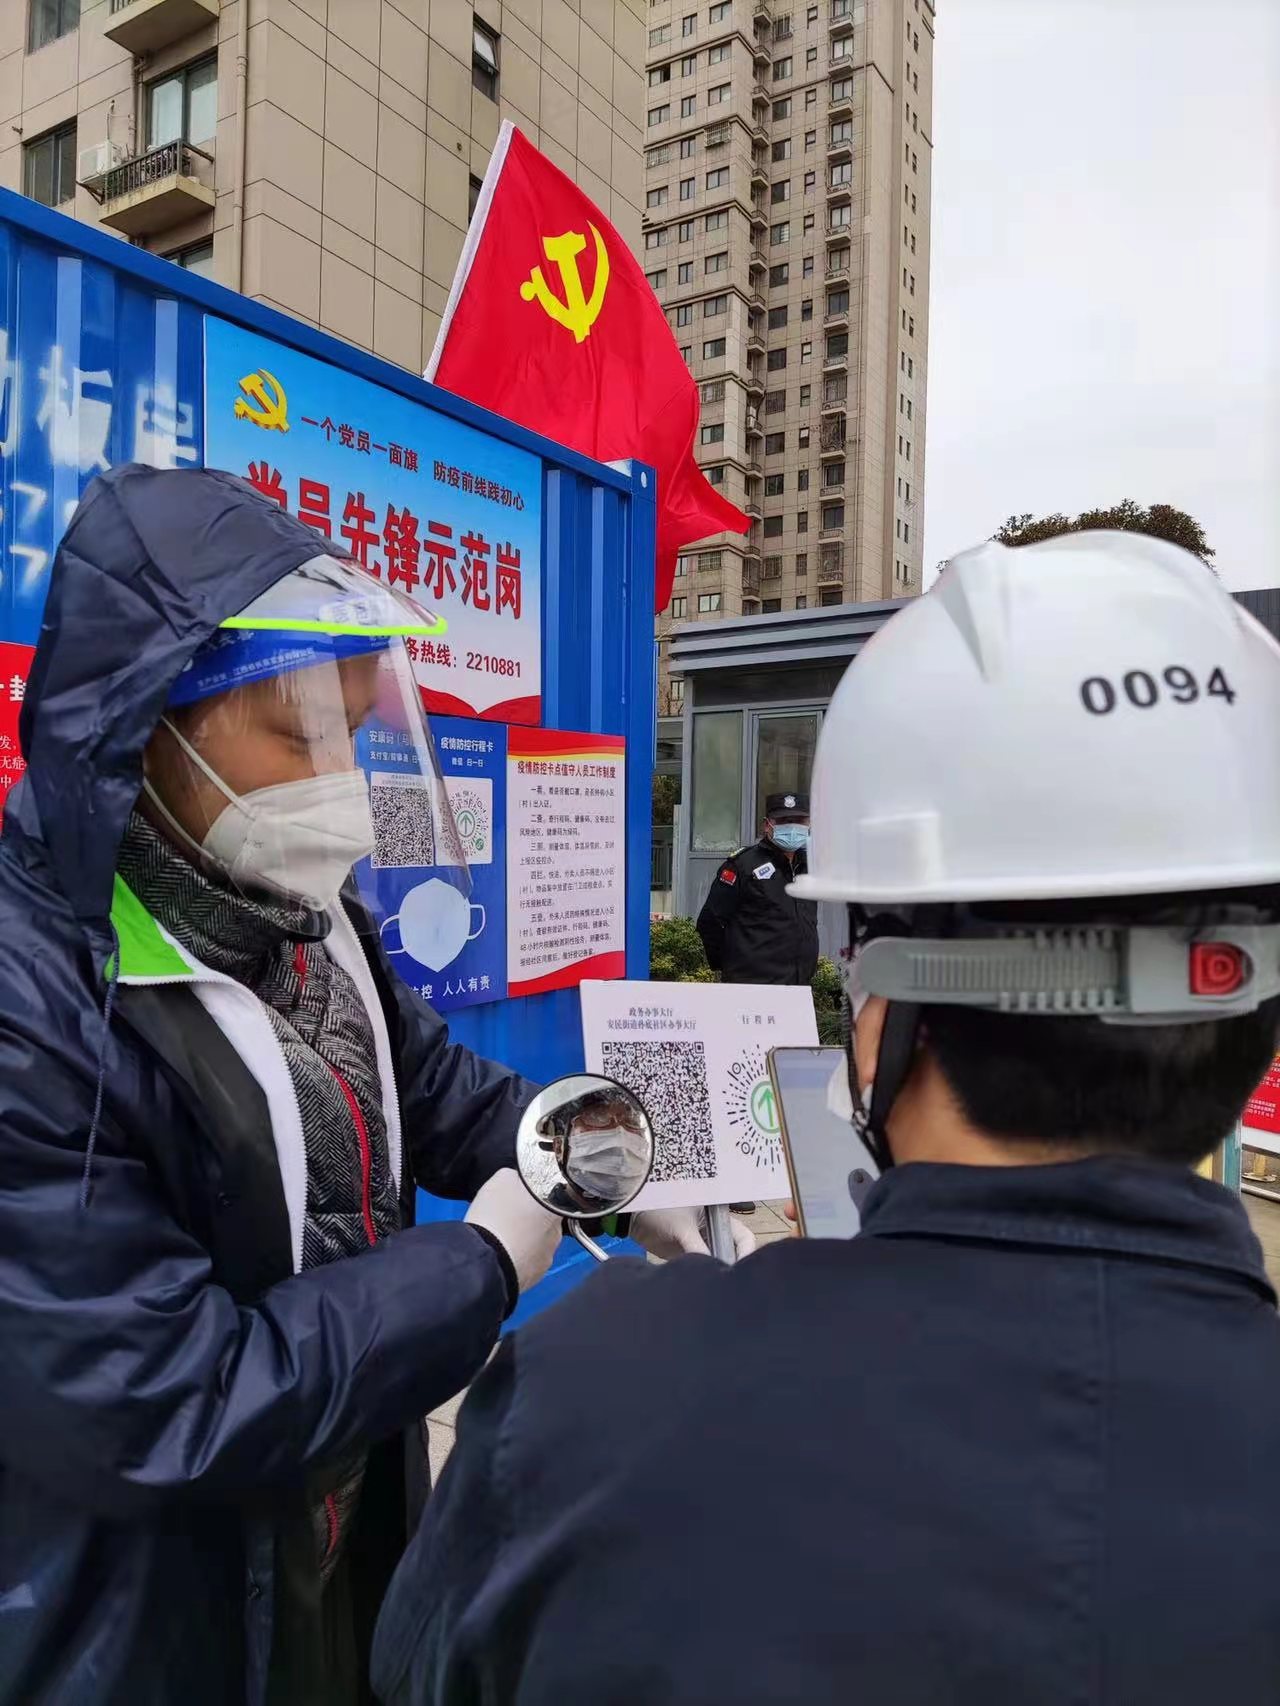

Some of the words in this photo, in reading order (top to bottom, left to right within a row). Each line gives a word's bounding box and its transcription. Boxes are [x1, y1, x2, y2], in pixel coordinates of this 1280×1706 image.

[301, 416, 418, 473] 一个党员一面旗
[433, 460, 525, 511] 防疫前线践初心
[1079, 665, 1237, 716] 0094
[441, 736, 494, 753] 疫情防控行程卡
[517, 760, 616, 779] 疫情防控卡点值守人员工作制度
[443, 975, 490, 997] 人人有责
